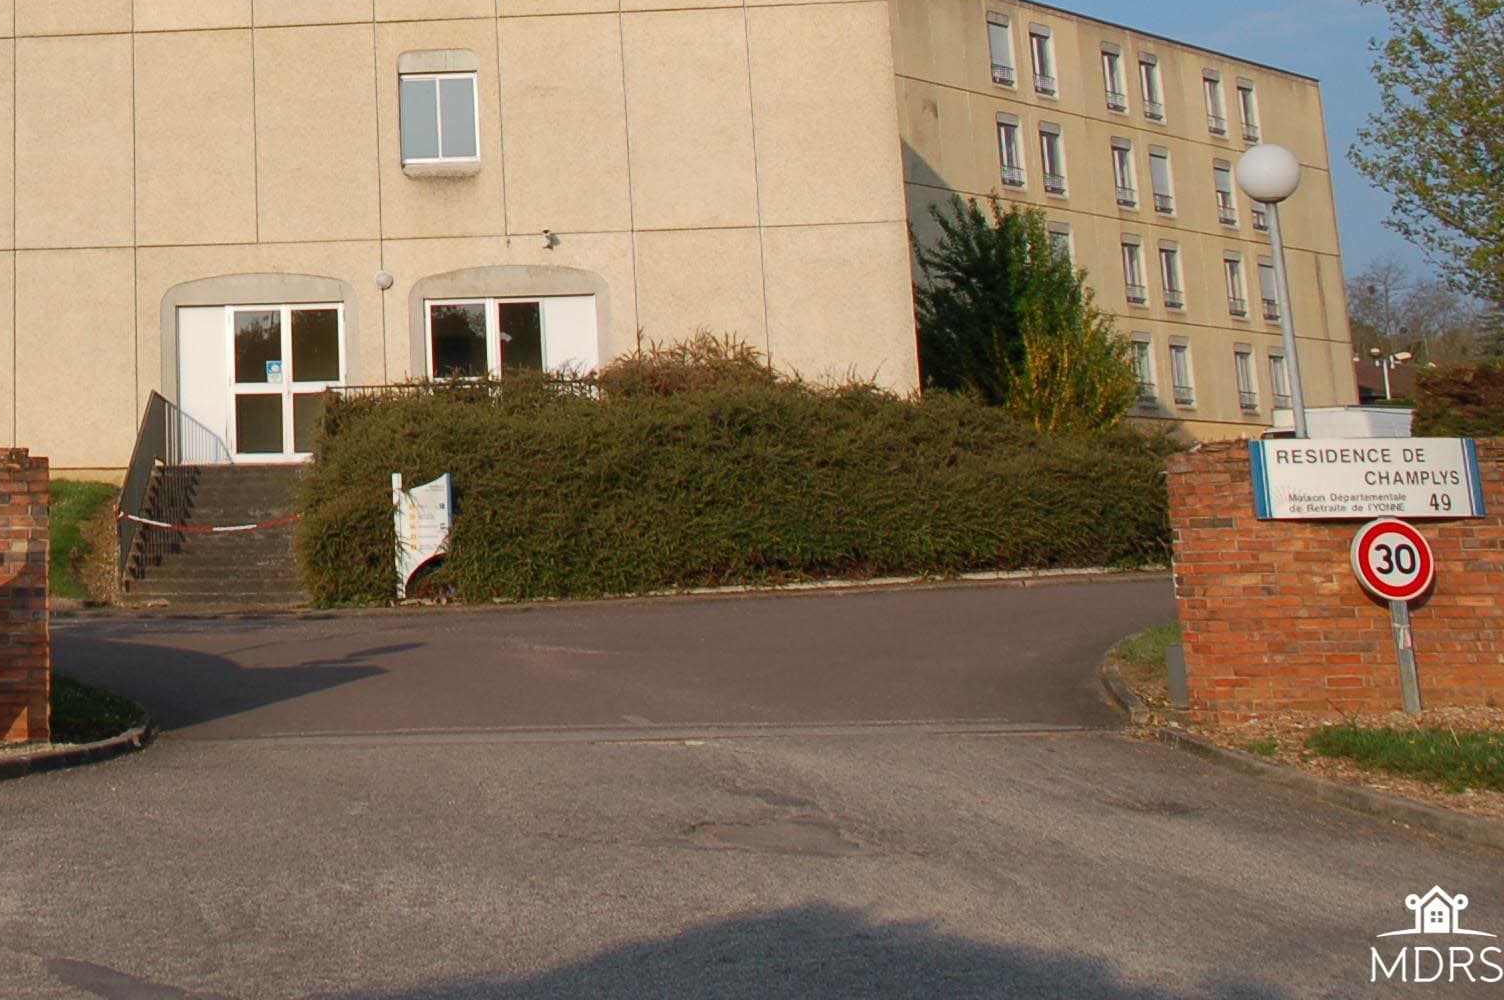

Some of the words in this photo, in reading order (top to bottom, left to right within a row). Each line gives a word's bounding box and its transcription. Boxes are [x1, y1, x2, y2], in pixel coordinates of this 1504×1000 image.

[1276, 448, 1392, 464] RESIDENCE
[1402, 448, 1426, 463] DE
[1364, 470, 1460, 485] CHAMPLYS
[1288, 493, 1326, 502] Maison
[1429, 493, 1452, 511] 49
[1289, 504, 1303, 513] de
[1306, 503, 1347, 512] Retraite
[1351, 503, 1364, 512] de
[1375, 544, 1416, 575] 30
